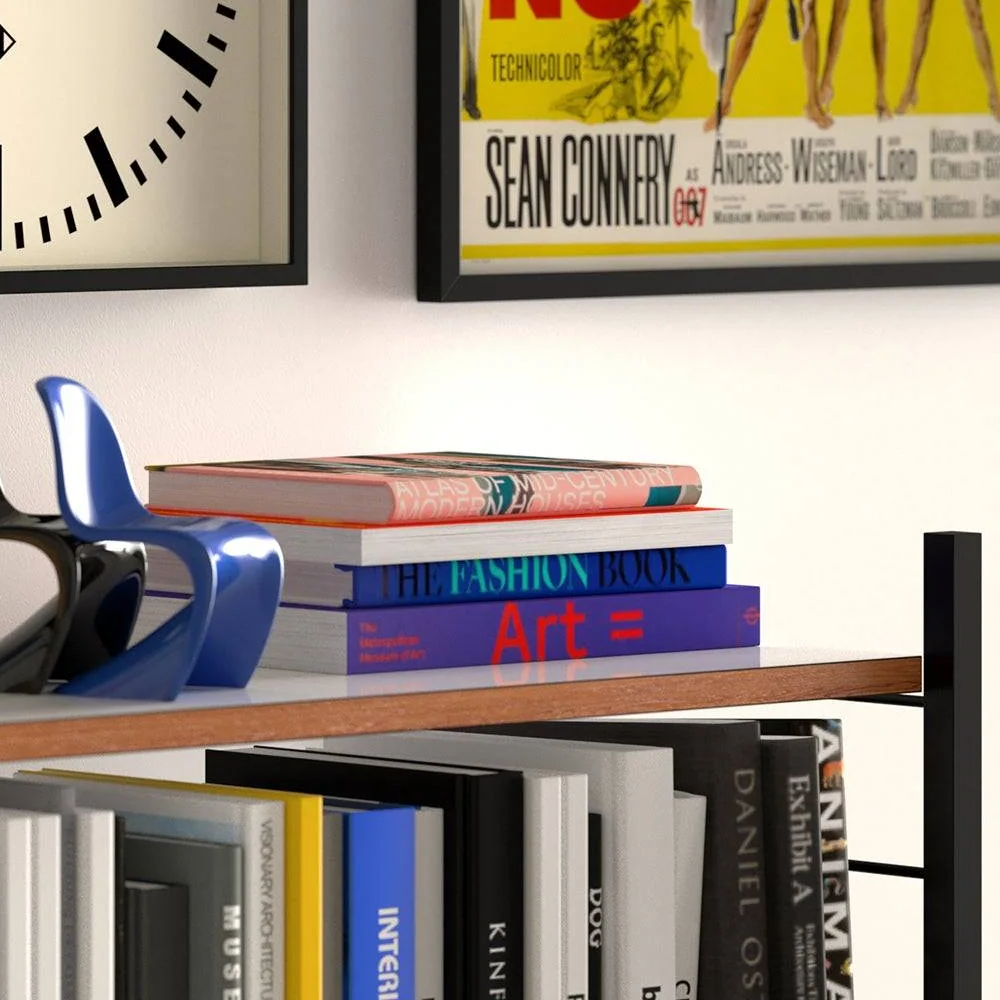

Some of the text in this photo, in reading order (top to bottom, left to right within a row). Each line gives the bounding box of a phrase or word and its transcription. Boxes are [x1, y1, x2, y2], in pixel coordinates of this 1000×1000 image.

[490, 53, 582, 83] TECHNICOLOR
[485, 133, 699, 229] SEAN CONNERY AS
[711, 138, 783, 185] ANDRESS
[791, 136, 867, 184] WISEMAN
[672, 186, 709, 228] 007
[395, 466, 675, 499] ATLAS OF MID-CENTURY
[399, 490, 607, 521] MODERN HOUSES
[380, 547, 691, 599] THE FASHION BOOK
[490, 600, 588, 665] Art
[259, 818, 274, 898] VISIONARY
[733, 768, 761, 916] DANIEL
[786, 774, 816, 906] Exhibit A
[588, 887, 602, 949] DOG
